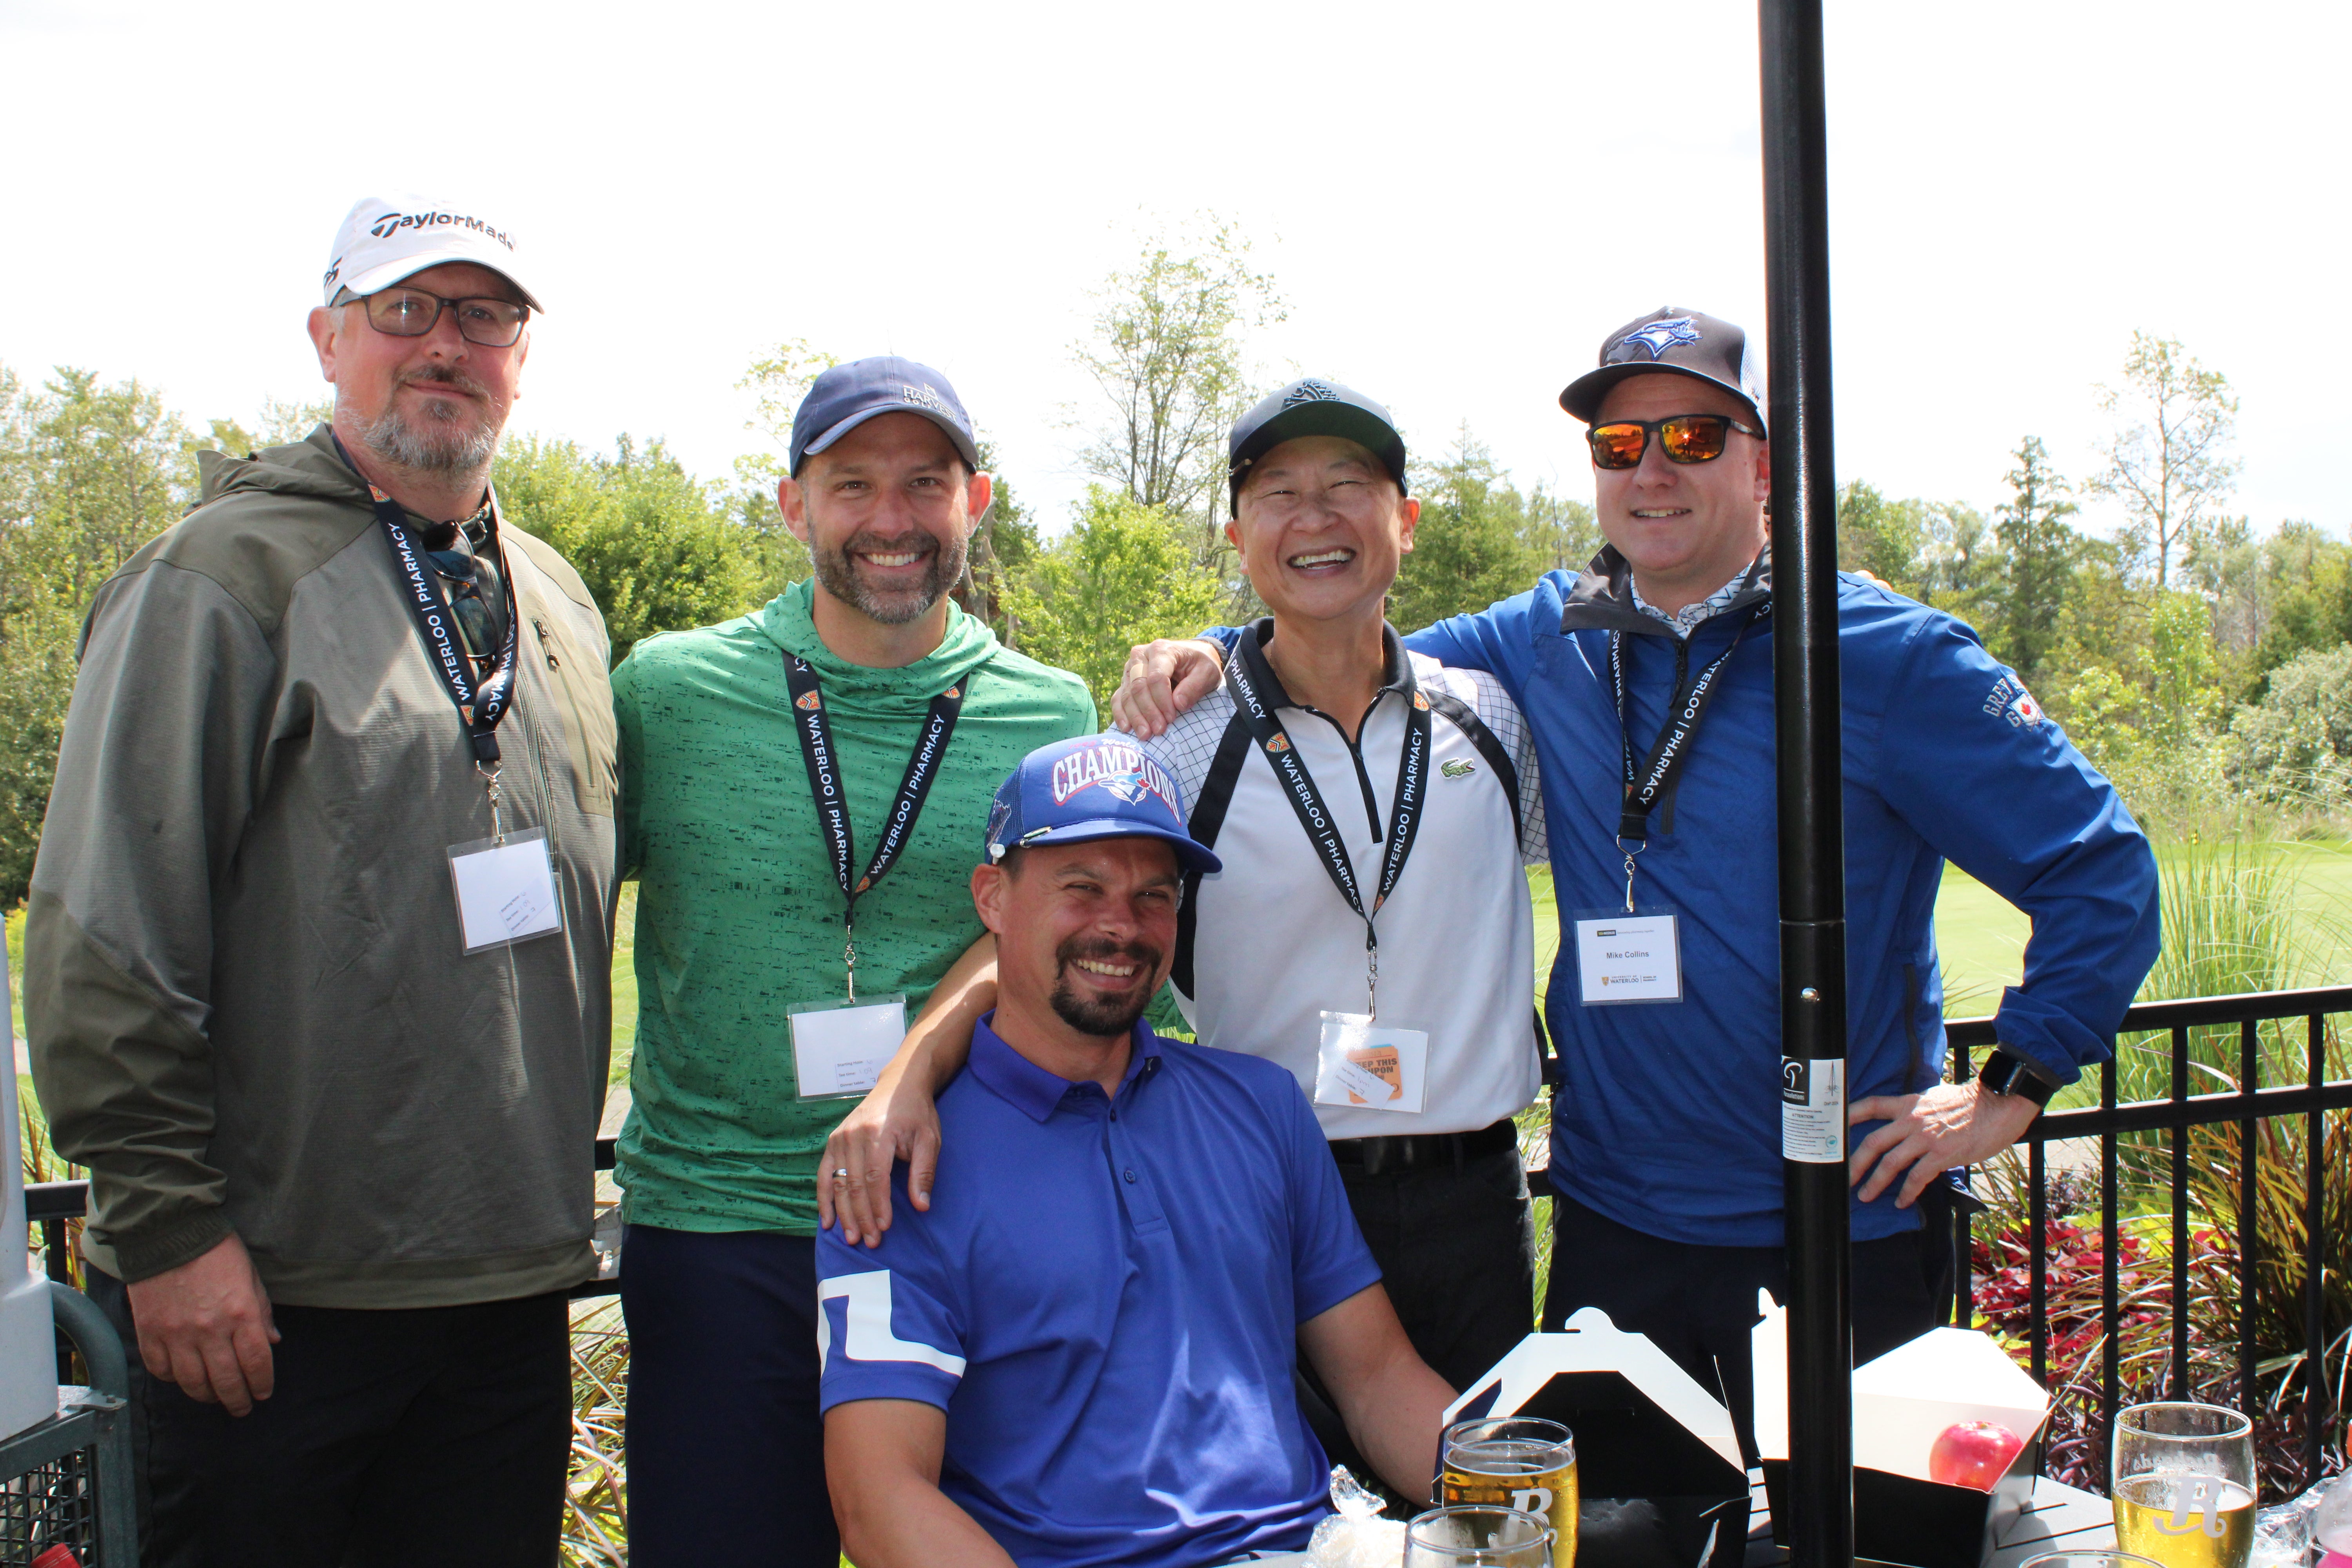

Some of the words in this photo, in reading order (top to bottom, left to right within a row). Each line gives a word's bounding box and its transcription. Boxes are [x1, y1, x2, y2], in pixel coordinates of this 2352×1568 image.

[371, 212, 514, 252] TaylorMade
[903, 387, 957, 422] HARVEST
[388, 523, 432, 602] PHARMACY
[428, 615, 470, 701] WATERLOO
[485, 650, 514, 721] PHARMACY
[1230, 659, 1267, 719] PHARMACY
[1683, 650, 1731, 719] WATERLOO
[1101, 739, 1137, 750] World
[1639, 730, 1685, 804] PHARMACY
[808, 715, 835, 797] WATERLOO
[829, 809, 848, 891] PHARMACY
[871, 800, 911, 874] WATERLOO
[909, 714, 945, 791] PHARMACY
[1052, 745, 1181, 827] CHAMPIONS
[1383, 814, 1410, 891] WATERLOO
[1403, 728, 1423, 802] PHARMACY
[1281, 754, 1325, 829] WATERLOO
[1324, 839, 1363, 913] PHARMACY
[1367, 1065, 1393, 1074] UPON
[1376, 1058, 1397, 1067] THIS
